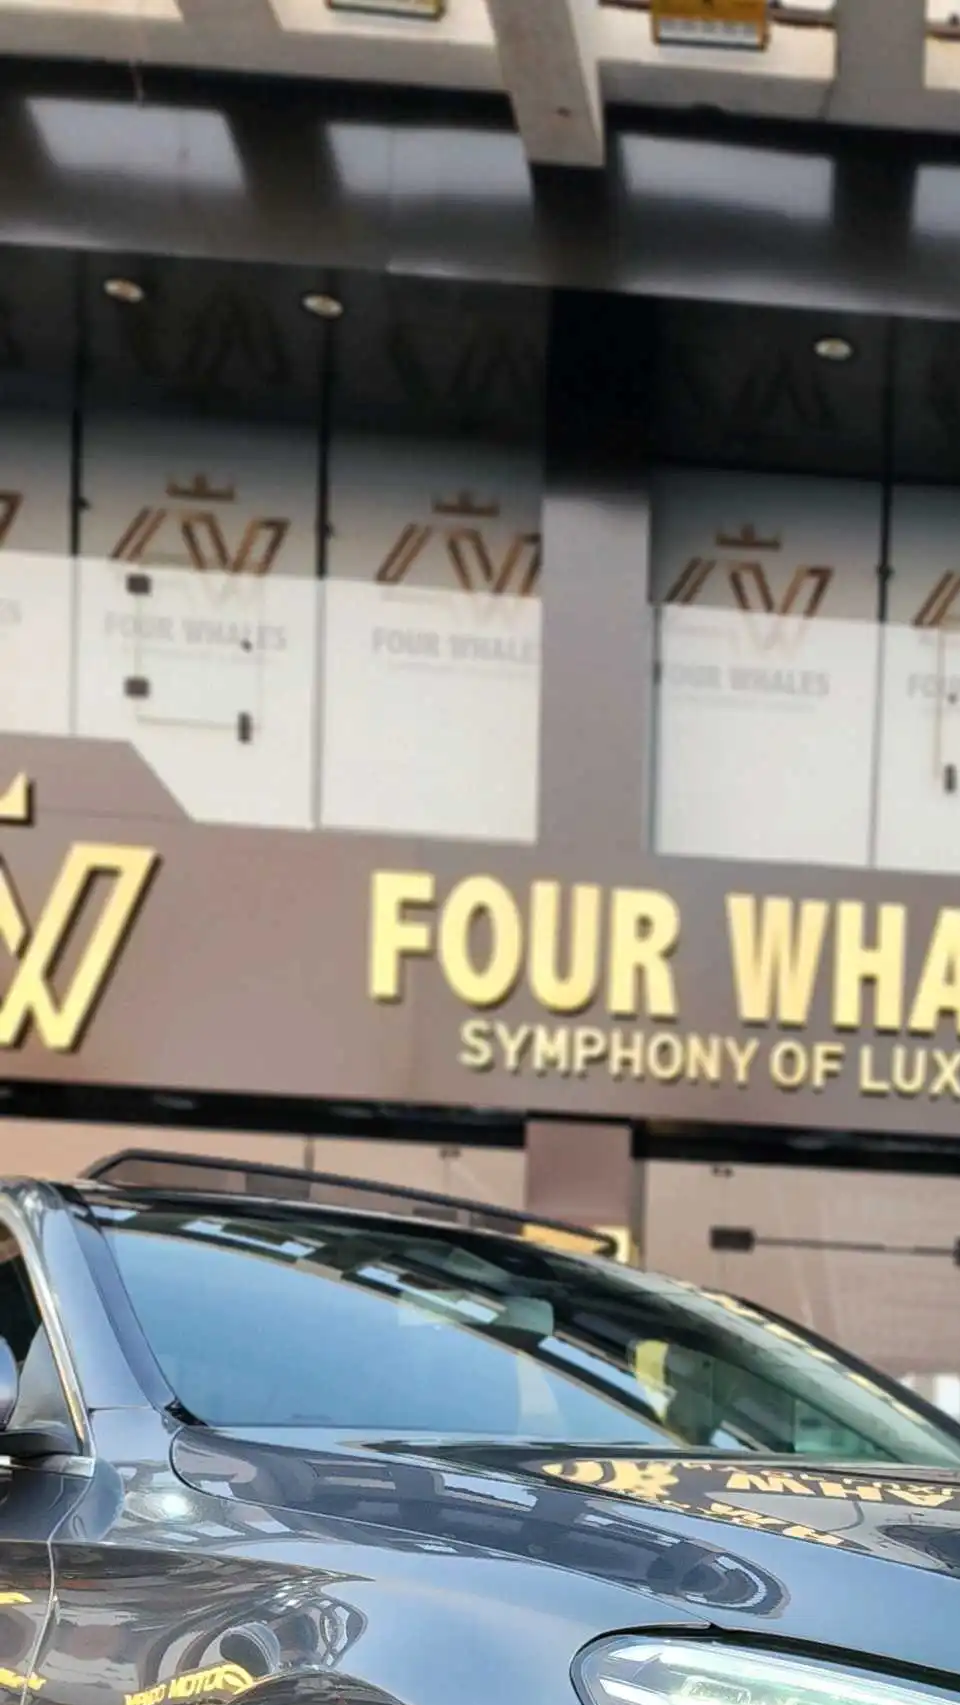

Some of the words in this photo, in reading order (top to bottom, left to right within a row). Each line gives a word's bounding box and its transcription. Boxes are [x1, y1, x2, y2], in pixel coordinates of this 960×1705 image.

[449, 633, 541, 668] WHALE
[369, 869, 681, 1020] FOUR
[459, 1018, 761, 1088] SYMPHONY
[768, 1038, 847, 1093] OF
